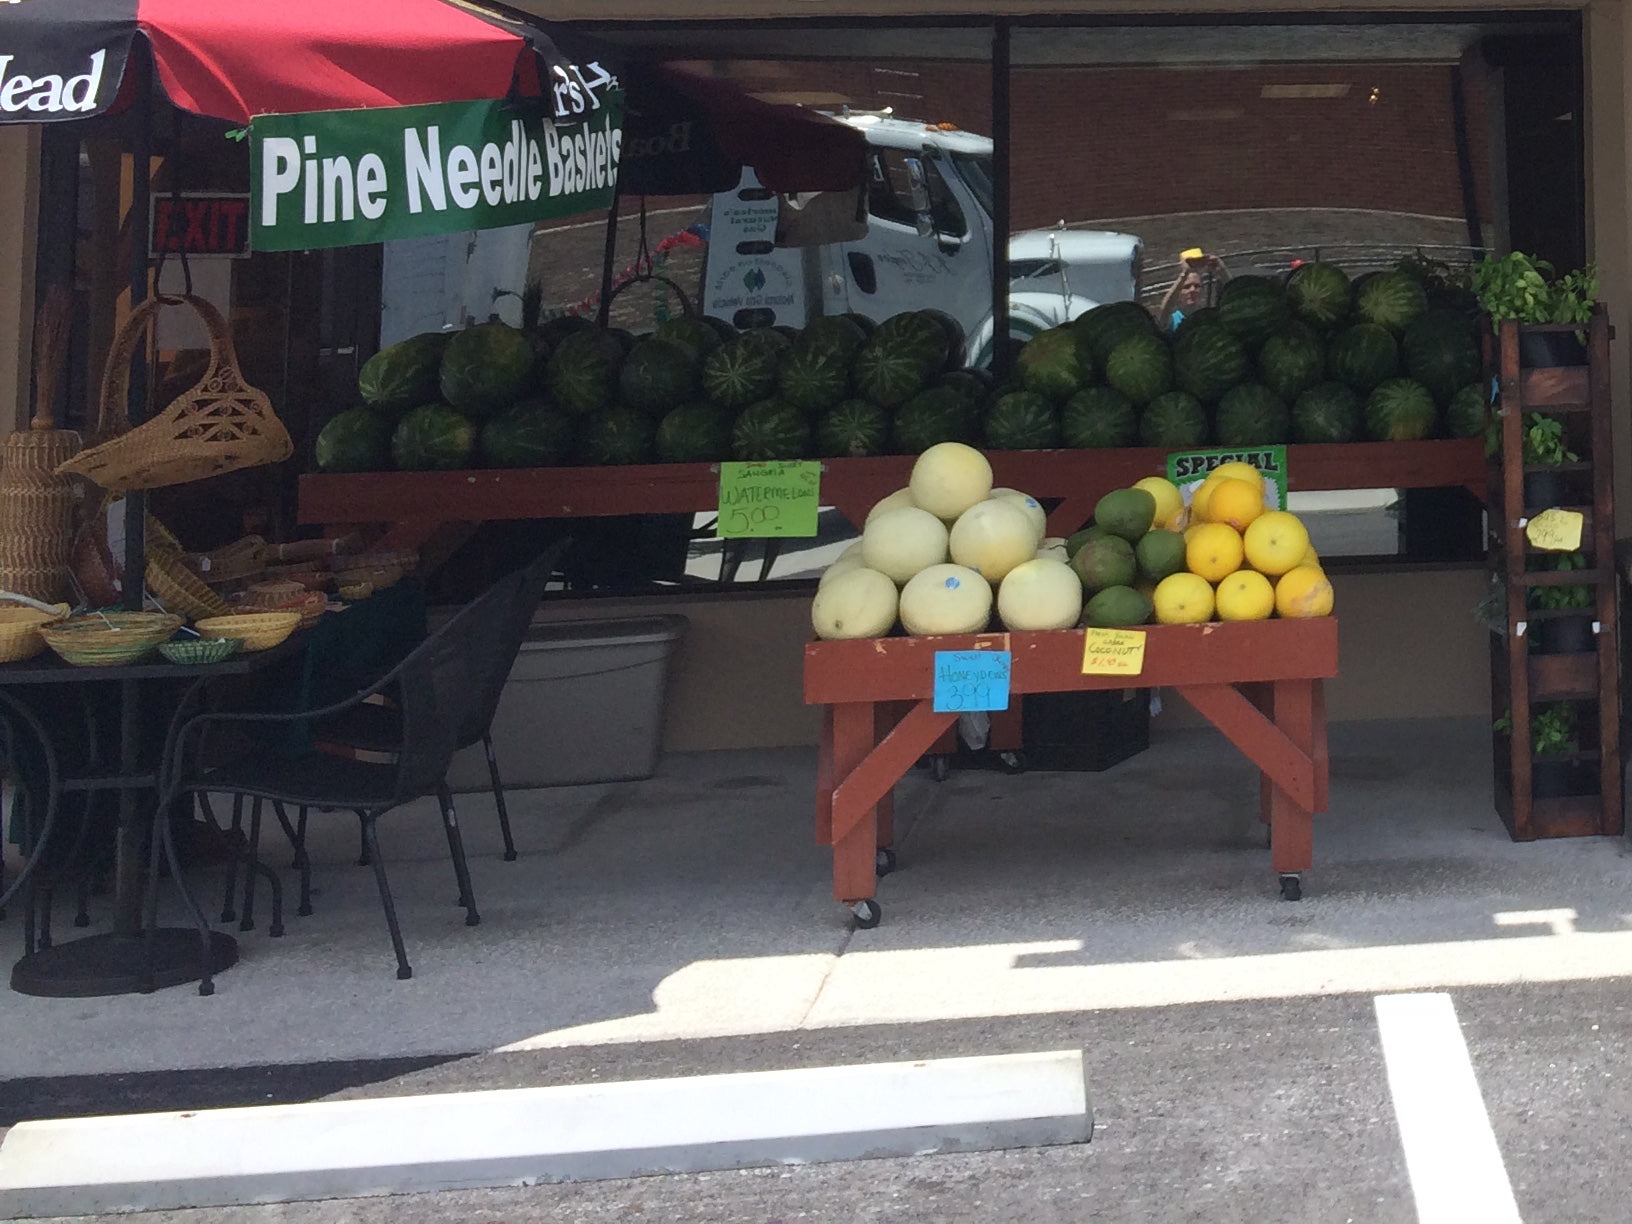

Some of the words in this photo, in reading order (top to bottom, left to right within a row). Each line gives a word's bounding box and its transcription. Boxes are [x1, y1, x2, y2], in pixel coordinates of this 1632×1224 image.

[0, 48, 106, 112] ead
[262, 135, 388, 226] Pine
[404, 119, 543, 214] Needle
[542, 111, 622, 197] Baskets
[156, 201, 244, 251] EXIT
